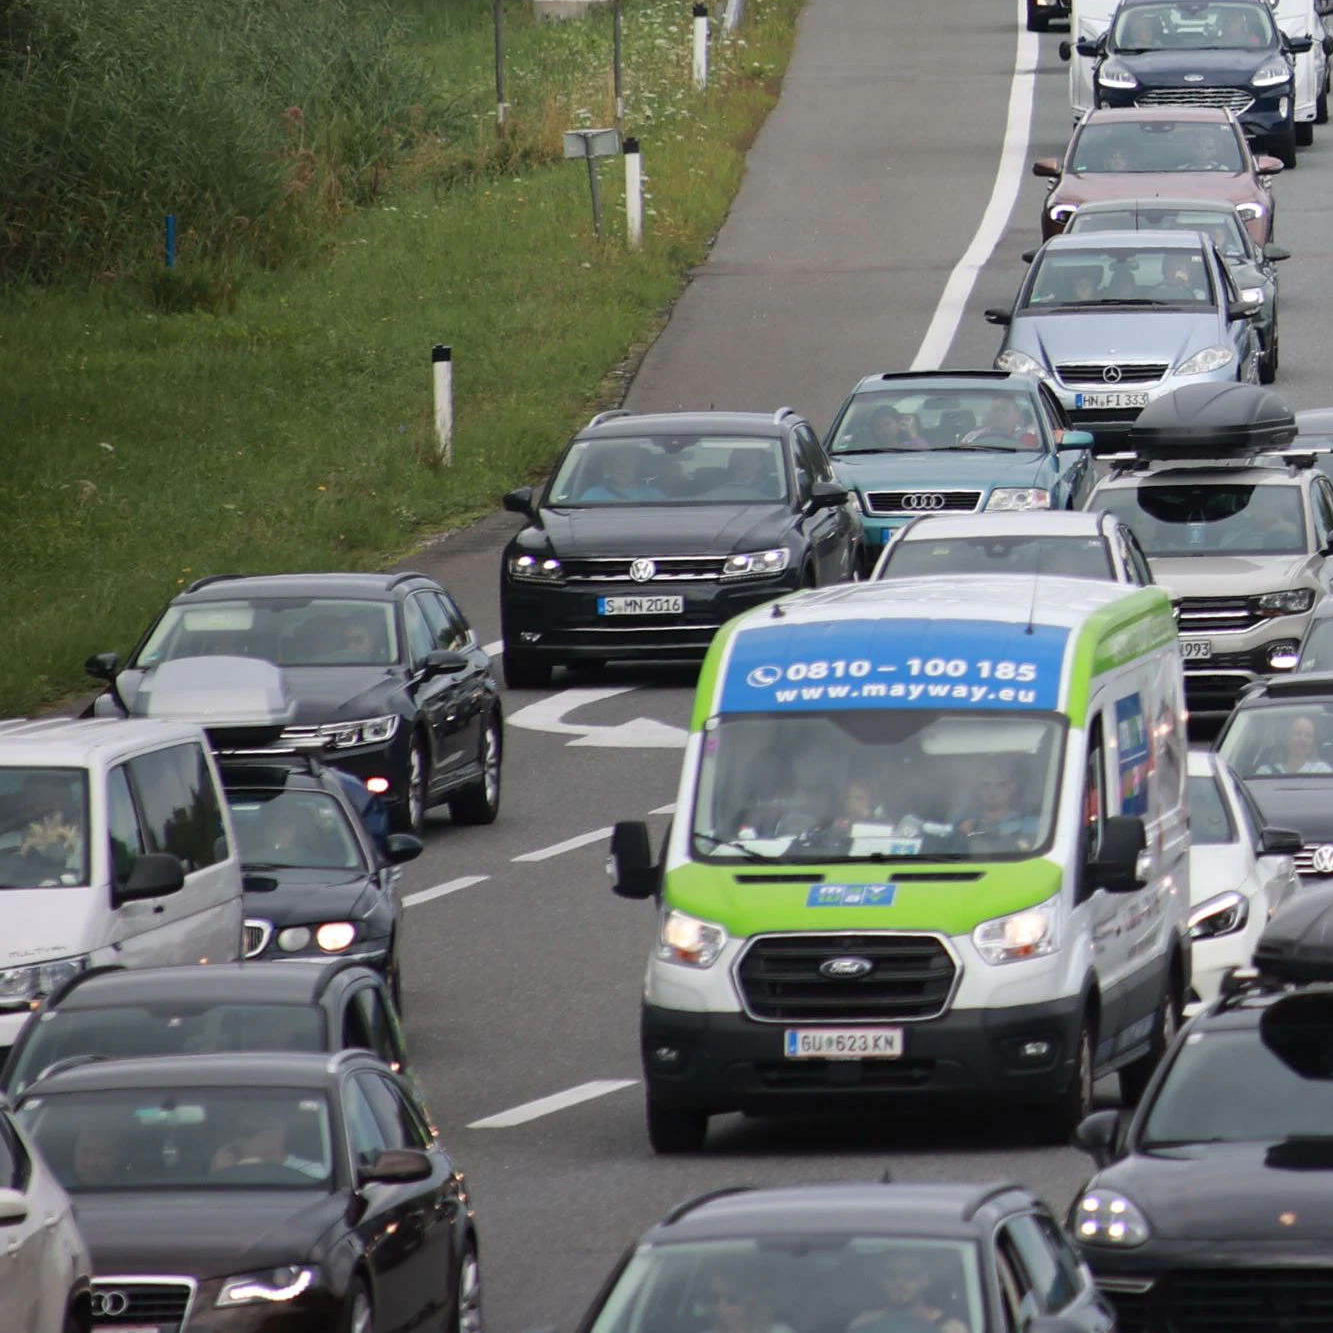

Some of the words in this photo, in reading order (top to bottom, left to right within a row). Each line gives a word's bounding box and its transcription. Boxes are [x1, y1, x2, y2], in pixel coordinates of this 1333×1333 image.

[1083, 394, 1098, 407] HN
[606, 599, 615, 613] S
[646, 598, 681, 612] 2016
[786, 661, 872, 681] 0810
[906, 658, 968, 677] 100
[976, 661, 1037, 682] 185
[775, 682, 1036, 704] www.mayway.eu
[801, 1035, 822, 1051] GU
[835, 1035, 869, 1052] 623
[871, 1035, 894, 1051] KN
